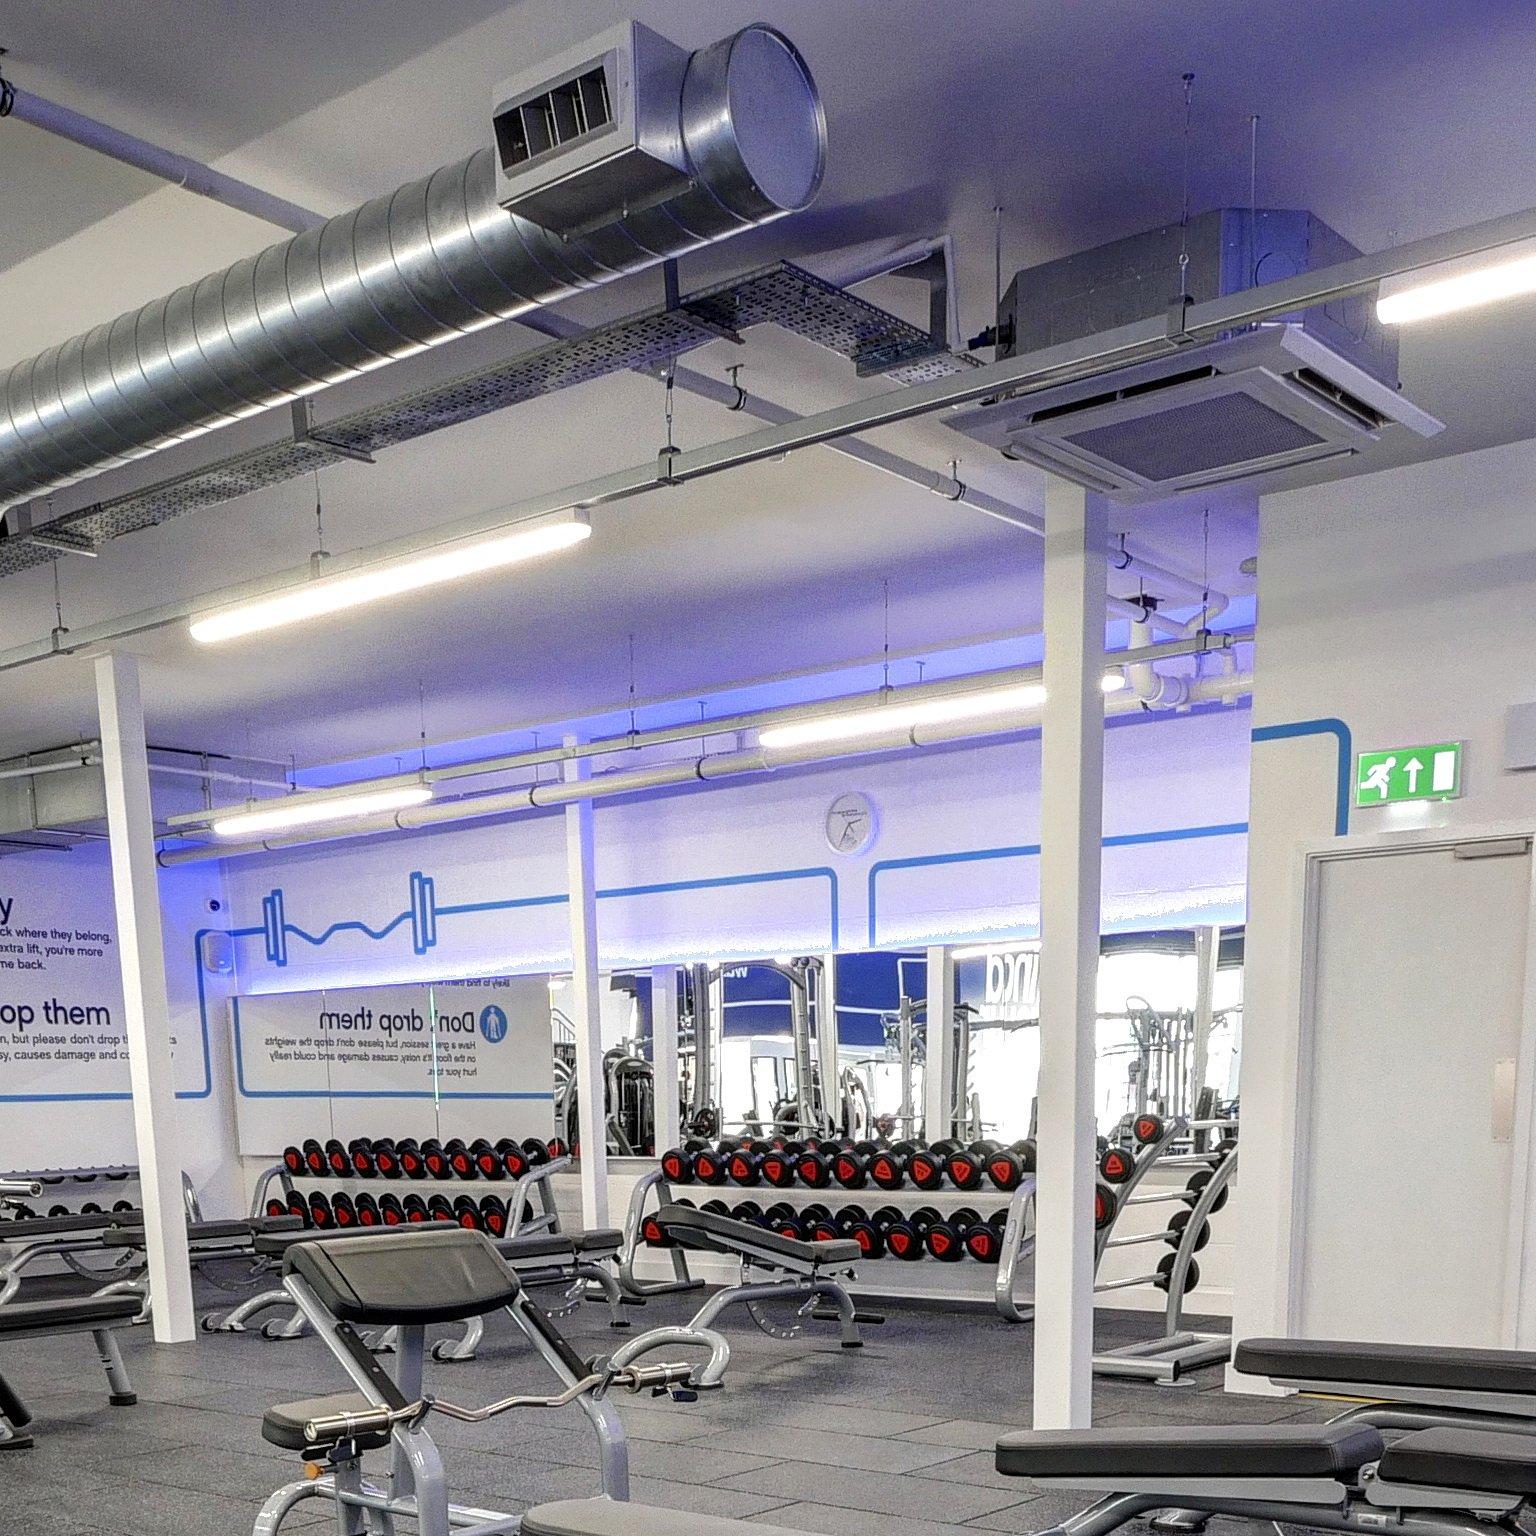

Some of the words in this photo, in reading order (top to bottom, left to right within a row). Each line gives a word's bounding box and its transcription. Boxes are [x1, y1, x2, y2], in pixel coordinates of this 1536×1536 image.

[14, 927, 48, 939] where
[50, 928, 72, 943] they
[77, 948, 103, 957] more
[42, 998, 111, 1026] them
[12, 1033, 30, 1044] but
[32, 1033, 66, 1047] please
[97, 1033, 120, 1047] drop
[14, 1052, 52, 1060] causes
[54, 1049, 96, 1062] damage
[99, 1049, 117, 1060] and
